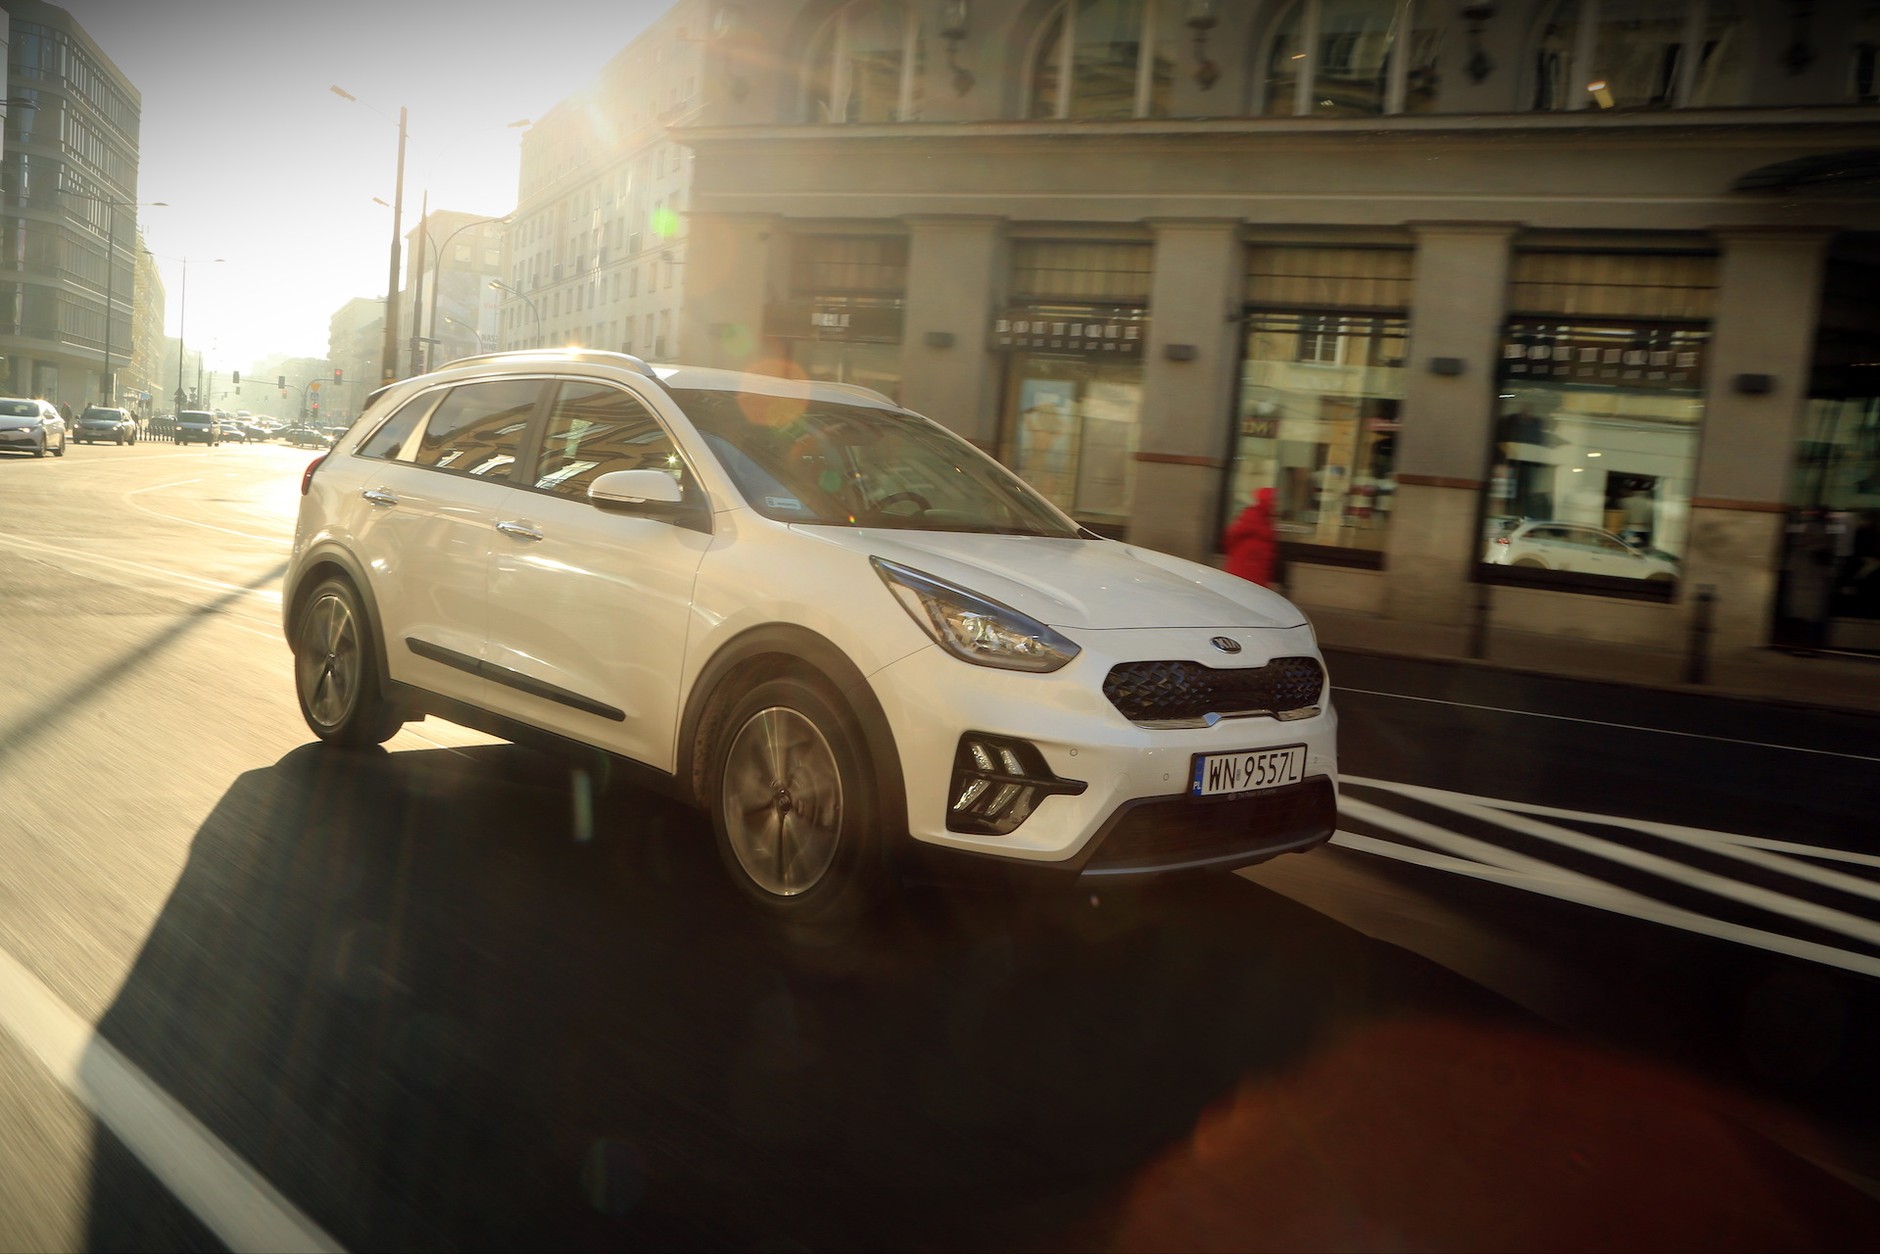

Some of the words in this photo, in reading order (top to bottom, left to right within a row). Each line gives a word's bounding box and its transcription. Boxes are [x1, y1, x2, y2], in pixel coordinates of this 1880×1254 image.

[1209, 757, 1237, 791] WN
[1243, 751, 1297, 787] 9557L
[1193, 781, 1201, 790] PL
